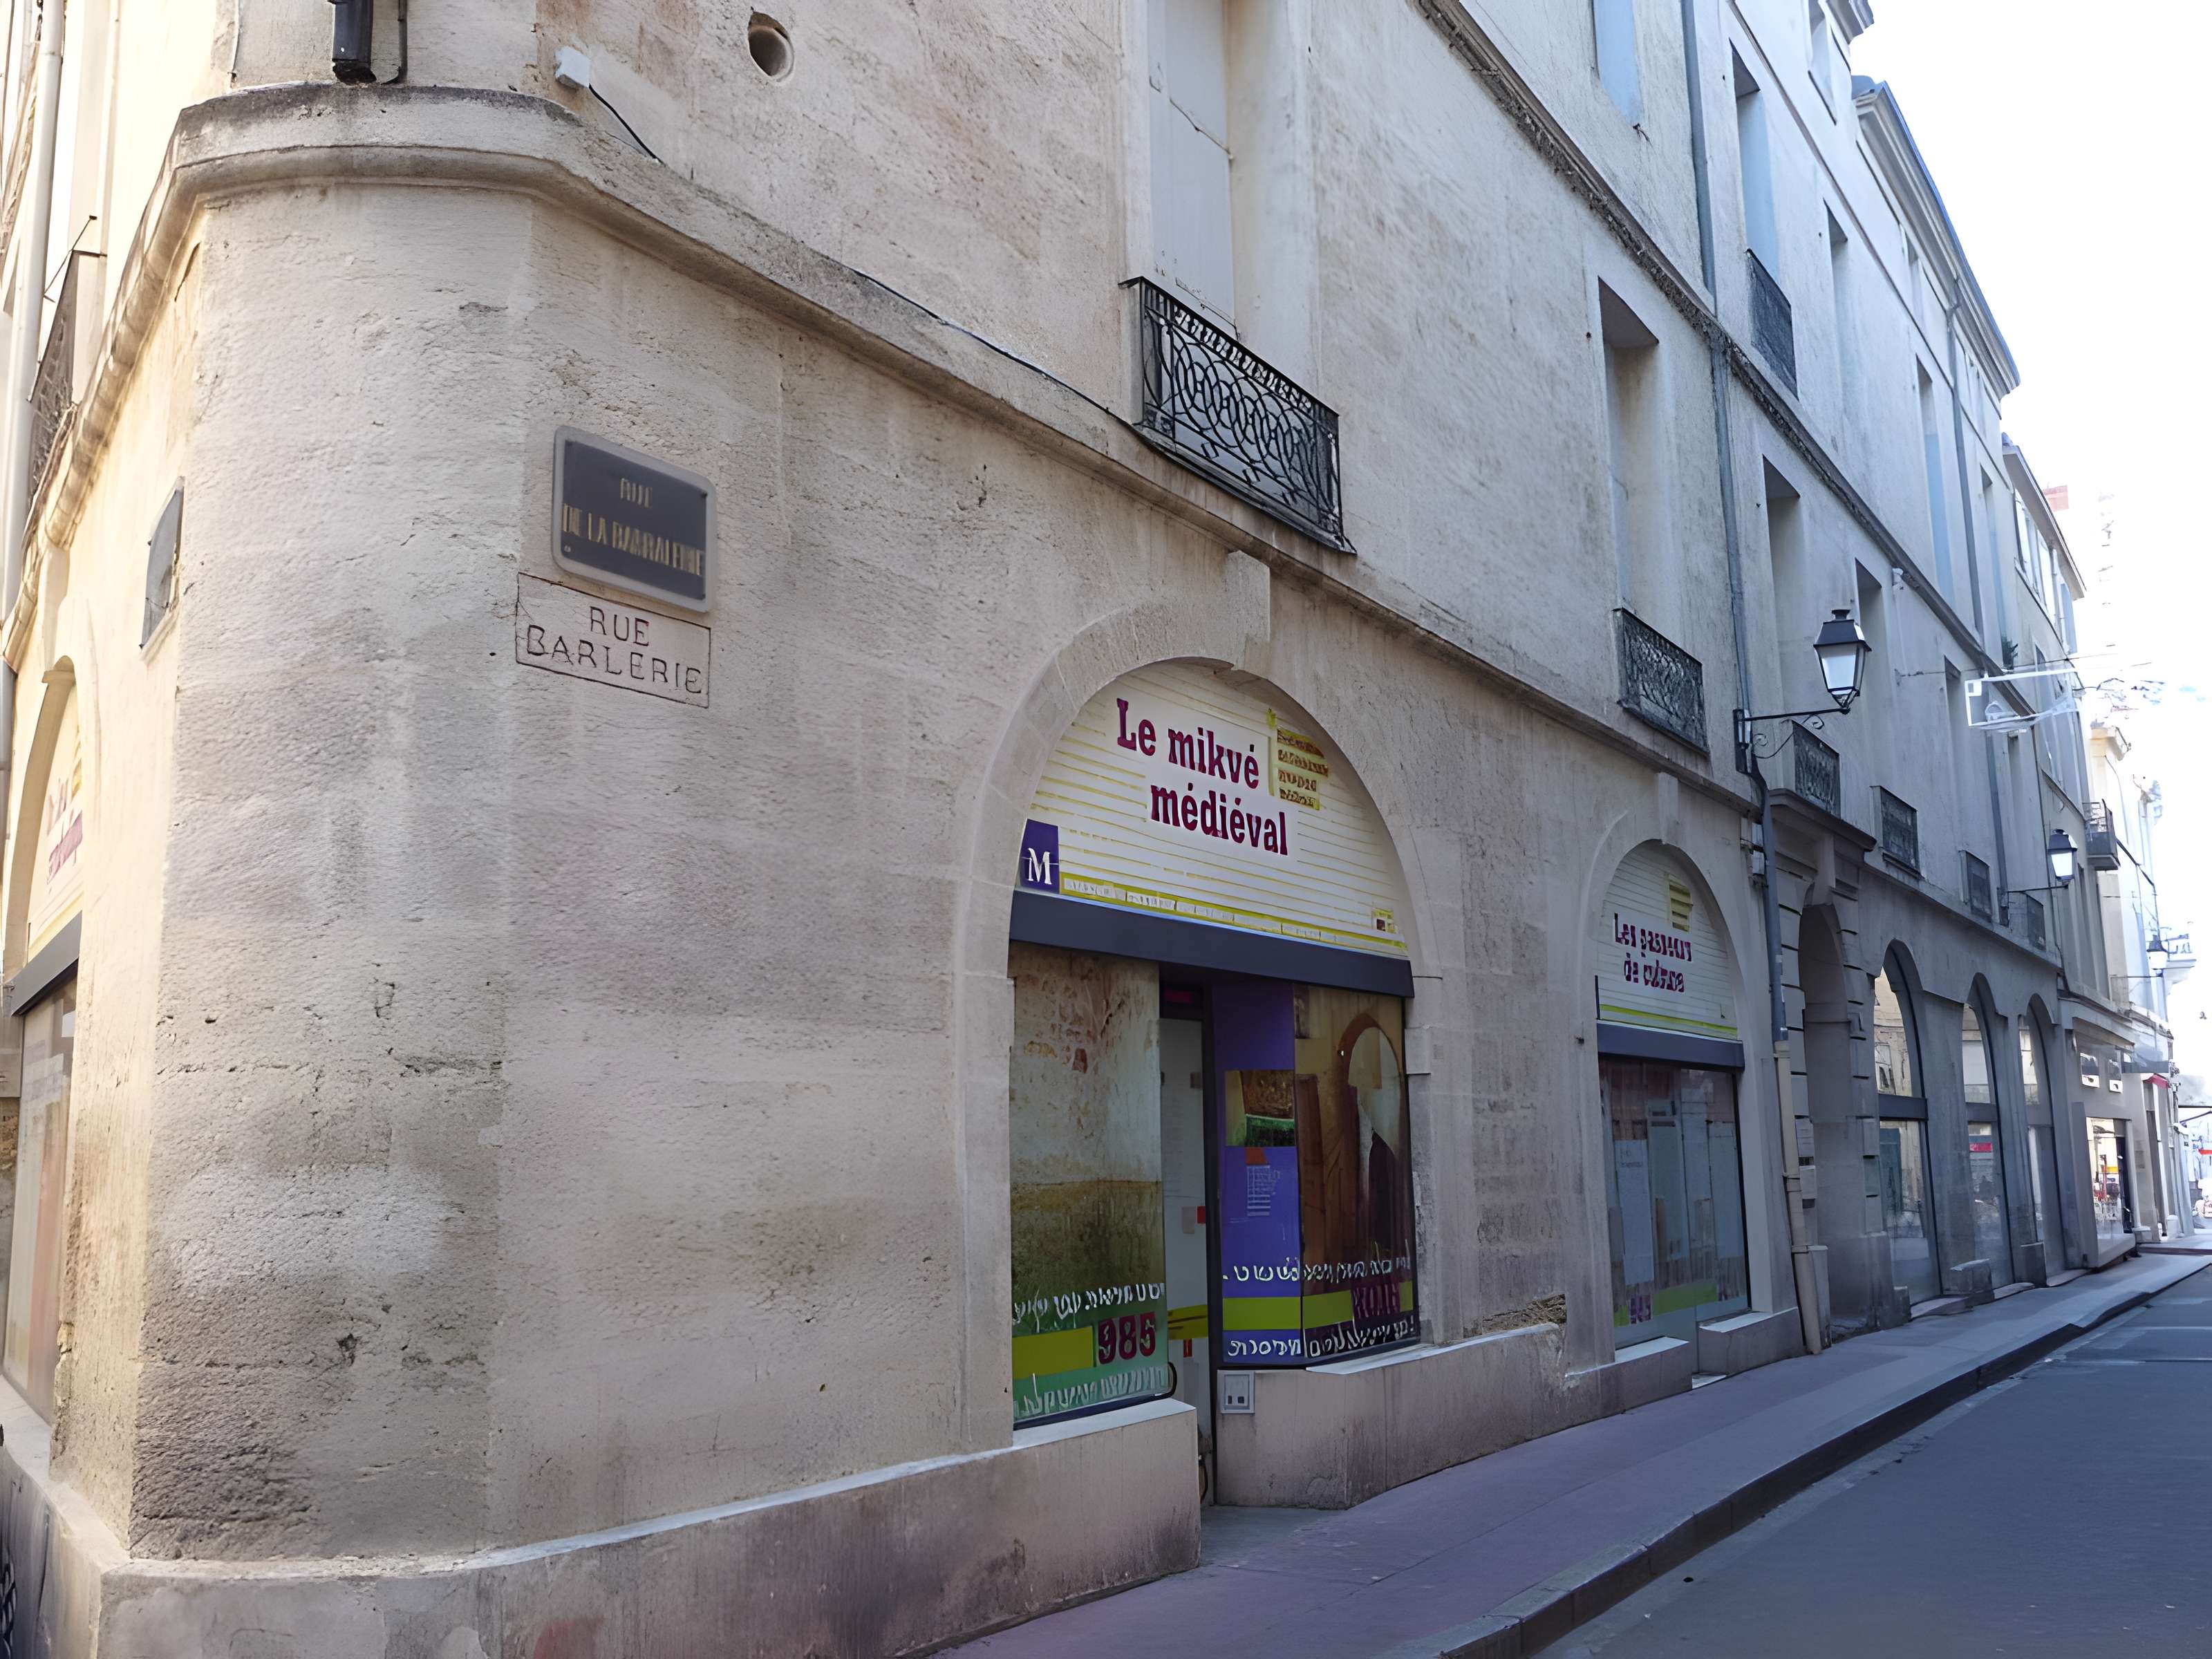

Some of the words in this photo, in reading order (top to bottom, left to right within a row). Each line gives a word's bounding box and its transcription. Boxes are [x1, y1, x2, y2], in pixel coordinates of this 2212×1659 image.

[590, 606, 650, 646] RUE
[526, 624, 702, 694] BARLERIE
[1116, 697, 1156, 756] Le
[1168, 727, 1259, 789] mikvé
[1150, 782, 1288, 856] médiéval
[1027, 847, 1052, 885] M
